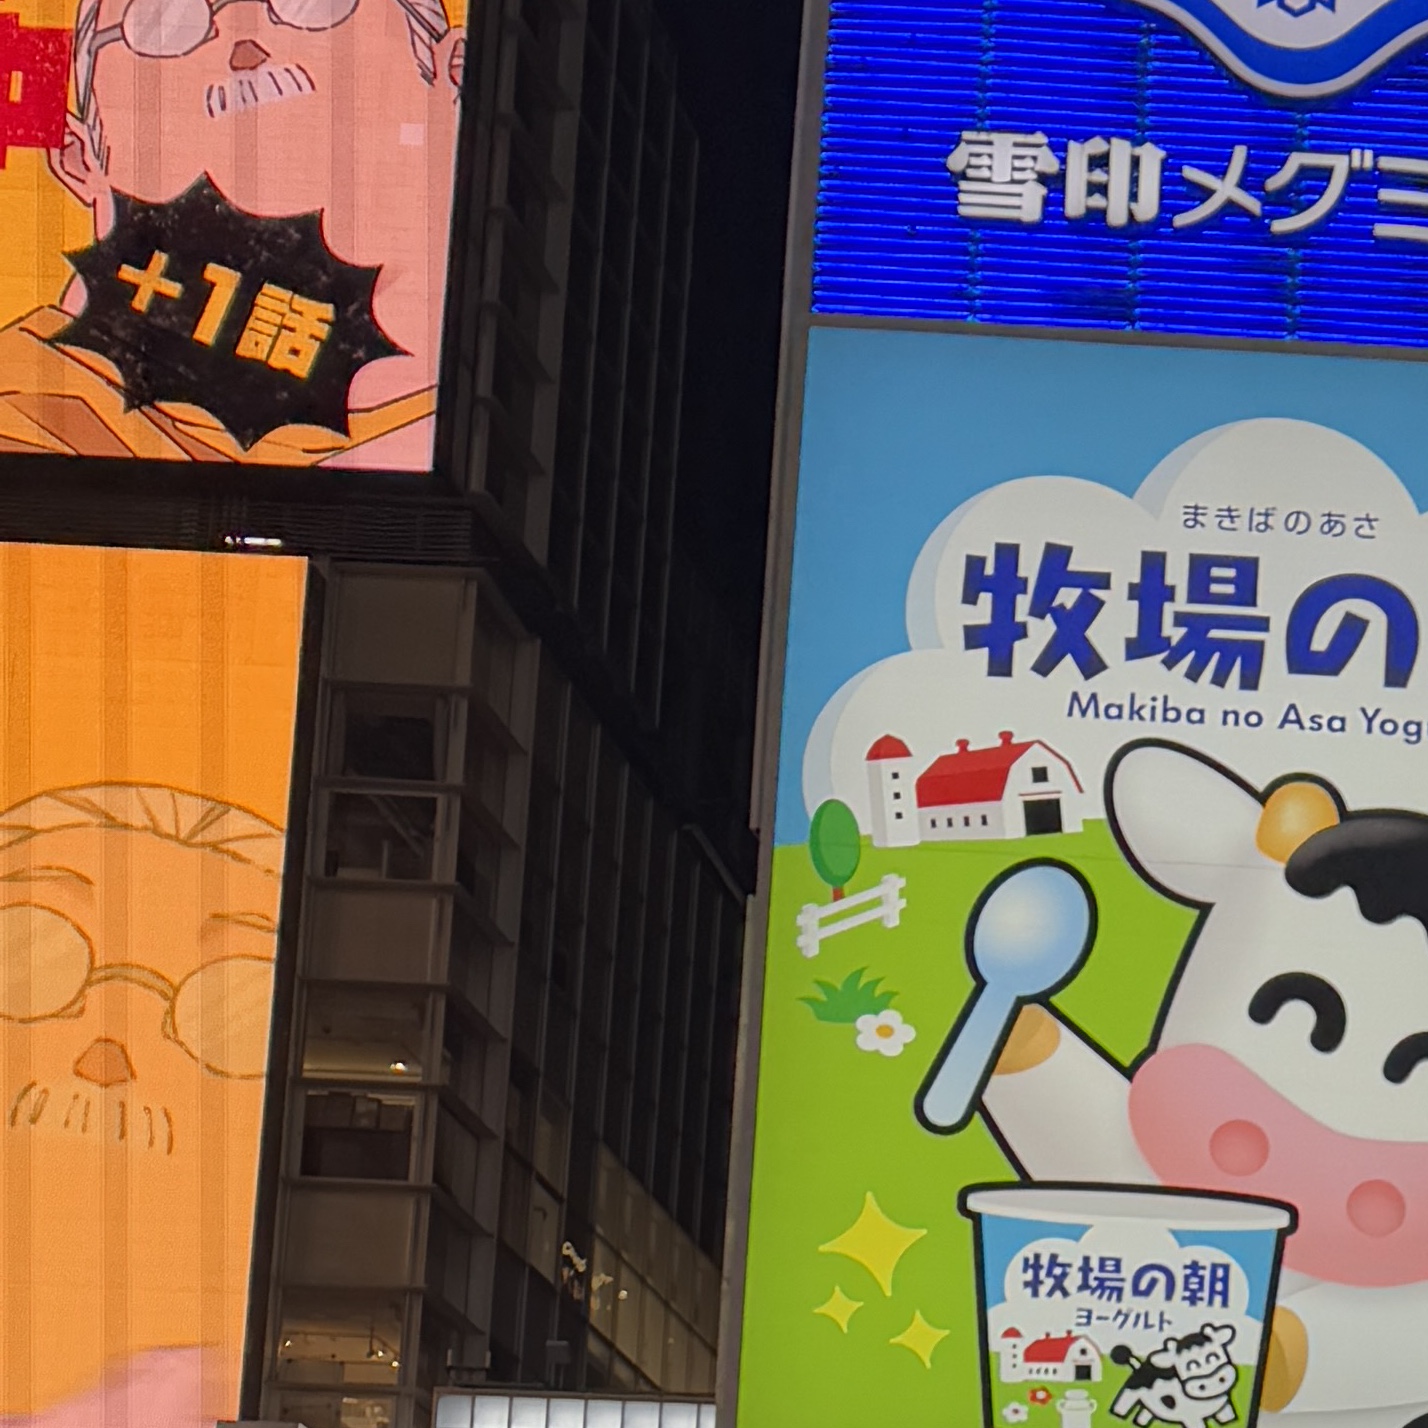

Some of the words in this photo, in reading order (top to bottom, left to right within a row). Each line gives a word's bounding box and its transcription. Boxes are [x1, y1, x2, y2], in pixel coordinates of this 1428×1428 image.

[1181, 501, 1380, 543] まきばのあさ
[1067, 690, 1207, 727] Makiba
[1221, 704, 1264, 730] no
[1278, 699, 1346, 734] Asa
[1020, 1250, 1231, 1308] 牧場の朝
[1075, 1307, 1173, 1332] ヨーグルト
